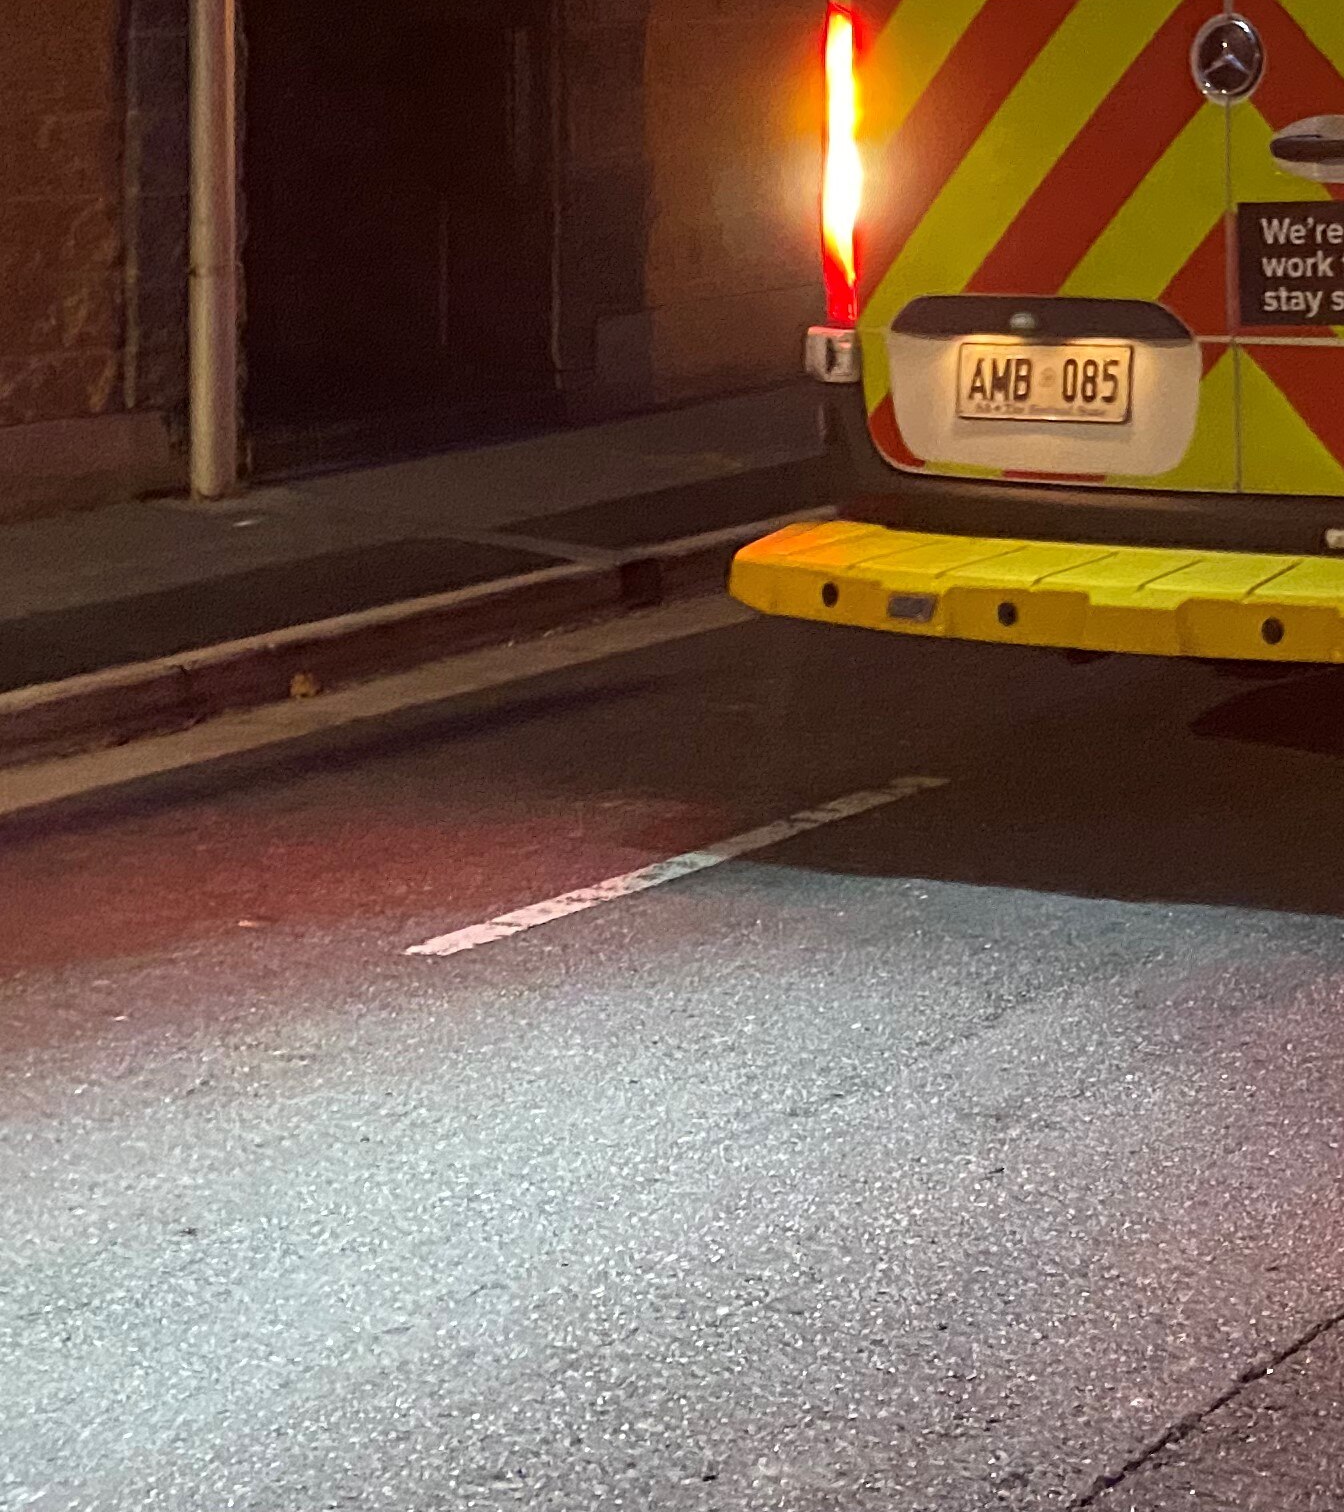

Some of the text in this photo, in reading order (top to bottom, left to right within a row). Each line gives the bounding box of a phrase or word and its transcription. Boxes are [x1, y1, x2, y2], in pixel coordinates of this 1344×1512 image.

[1260, 217, 1344, 245] We're
[1262, 250, 1334, 278] work
[1263, 286, 1324, 318] stay
[968, 358, 1121, 404] AMB 085
